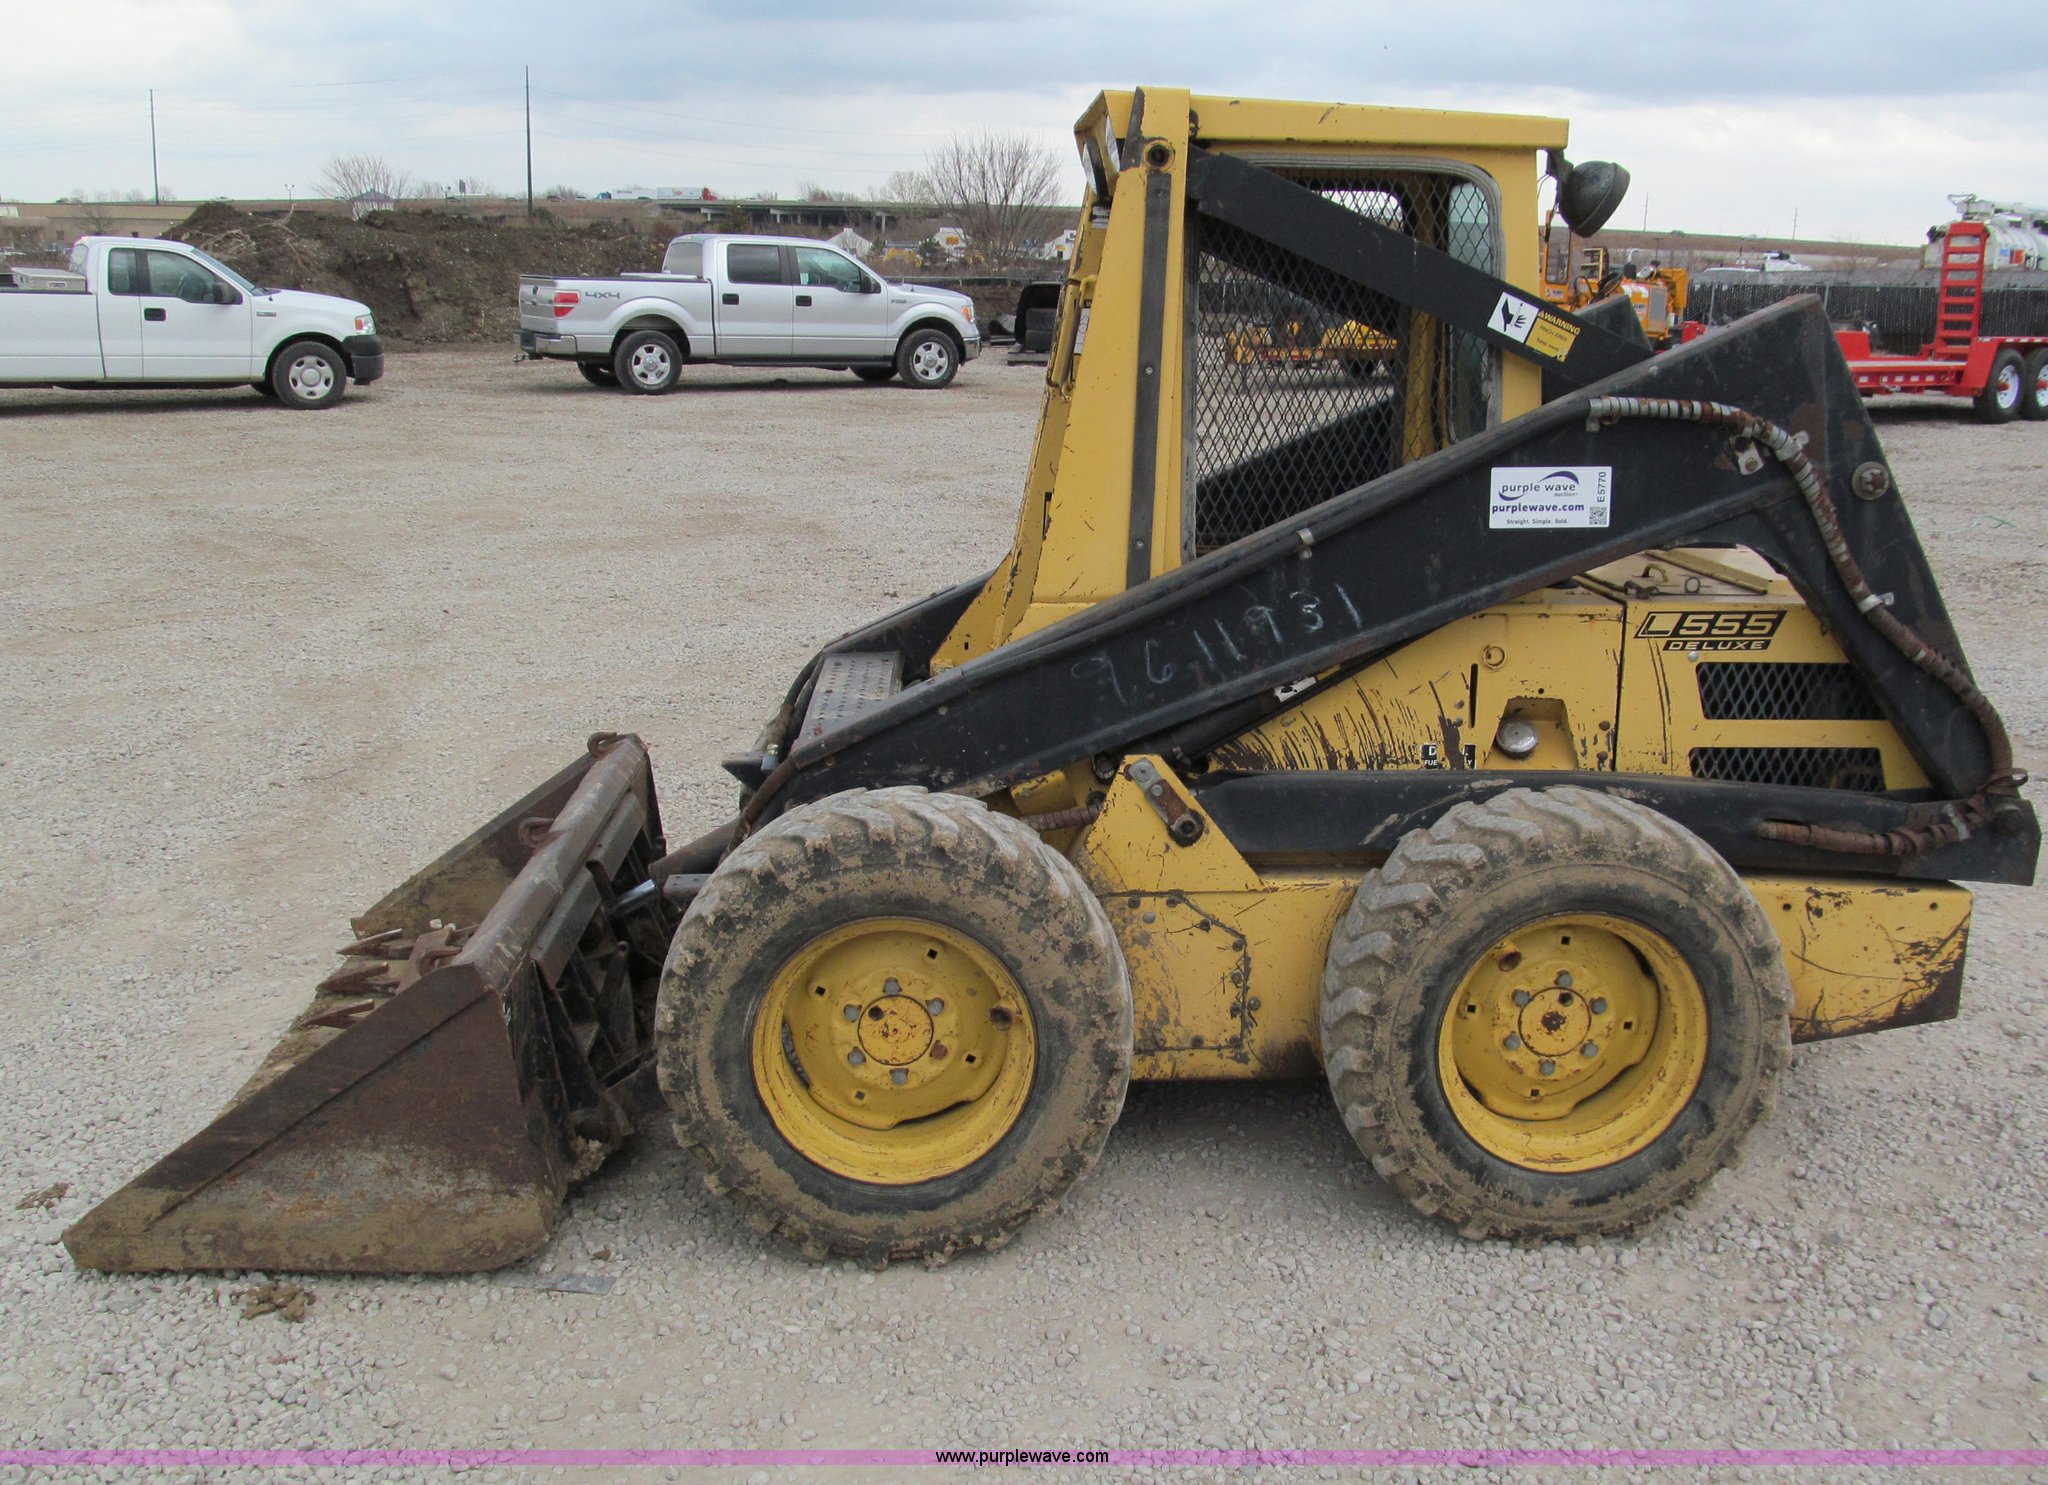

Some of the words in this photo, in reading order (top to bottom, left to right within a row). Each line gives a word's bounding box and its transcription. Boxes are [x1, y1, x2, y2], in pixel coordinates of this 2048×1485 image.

[1544, 312, 1580, 336] WARNING
[1502, 482, 1540, 493] purple
[1596, 471, 1607, 503] E5770
[1492, 502, 1585, 514] purplewave.com
[1638, 613, 1778, 636] L555
[1668, 640, 1766, 650] DELUXE
